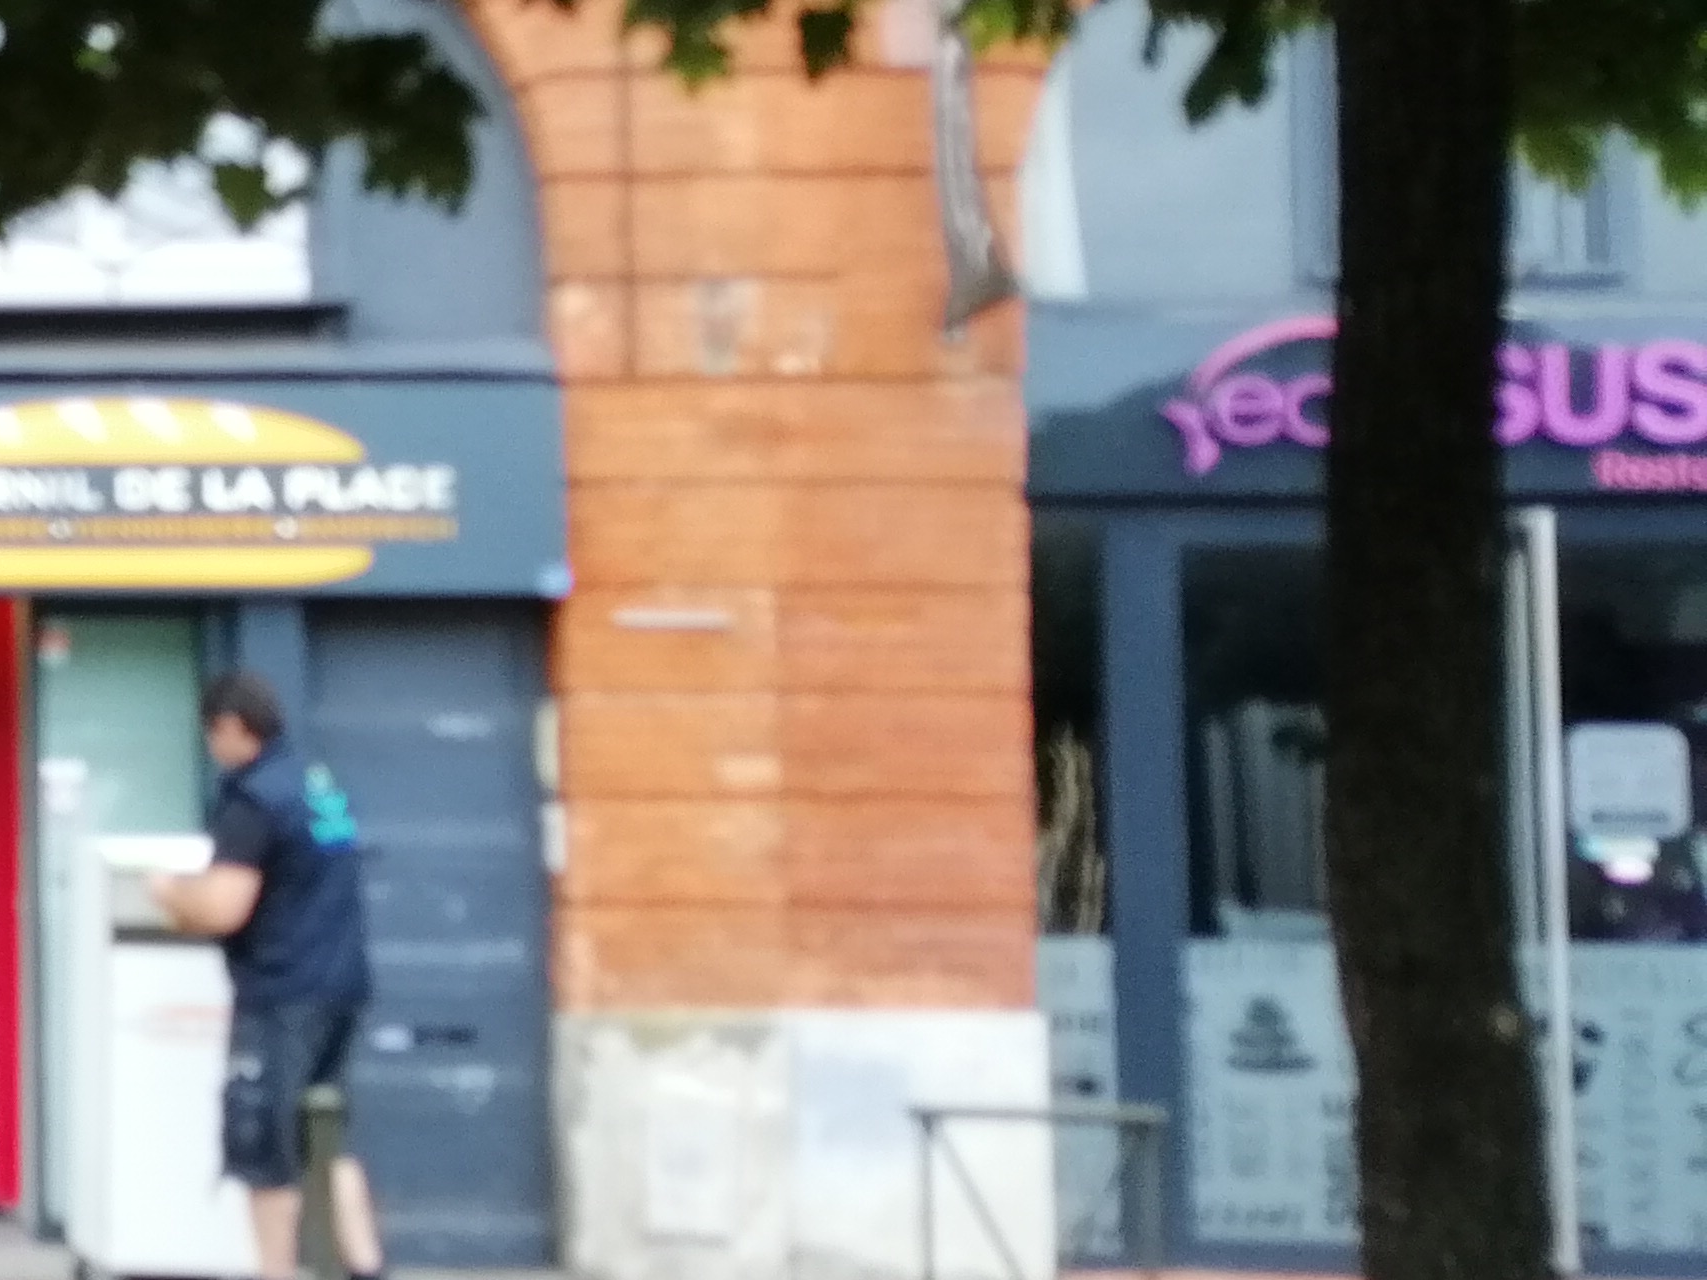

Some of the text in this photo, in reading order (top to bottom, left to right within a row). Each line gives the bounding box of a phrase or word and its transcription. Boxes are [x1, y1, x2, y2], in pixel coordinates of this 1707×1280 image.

[113, 467, 189, 512] DE
[201, 466, 276, 512] LA
[283, 464, 457, 511] PLACE
